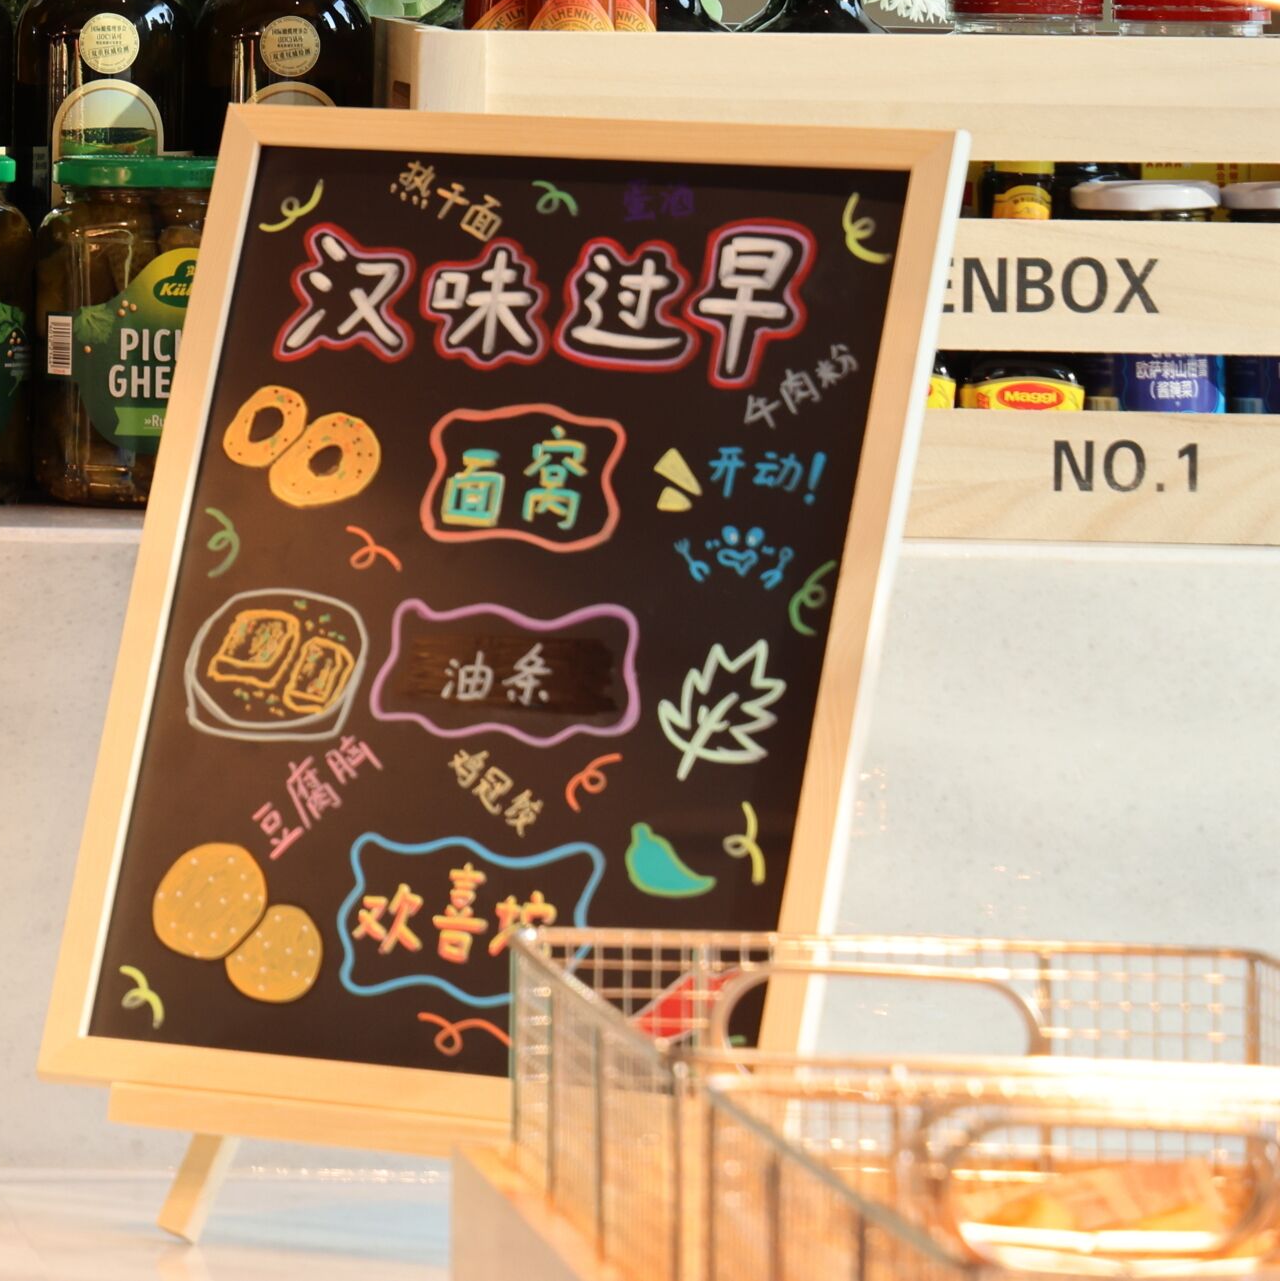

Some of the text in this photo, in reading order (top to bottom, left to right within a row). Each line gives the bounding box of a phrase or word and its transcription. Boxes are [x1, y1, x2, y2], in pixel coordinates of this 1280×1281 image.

[390, 160, 502, 242] 热干面
[280, 228, 790, 378] 汉味过早
[744, 344, 859, 429] 牛肉粉
[1003, 390, 1057, 405] Maggi
[441, 427, 588, 530] 面窝
[1053, 439, 1201, 493] NO.1
[442, 647, 551, 707] 油条
